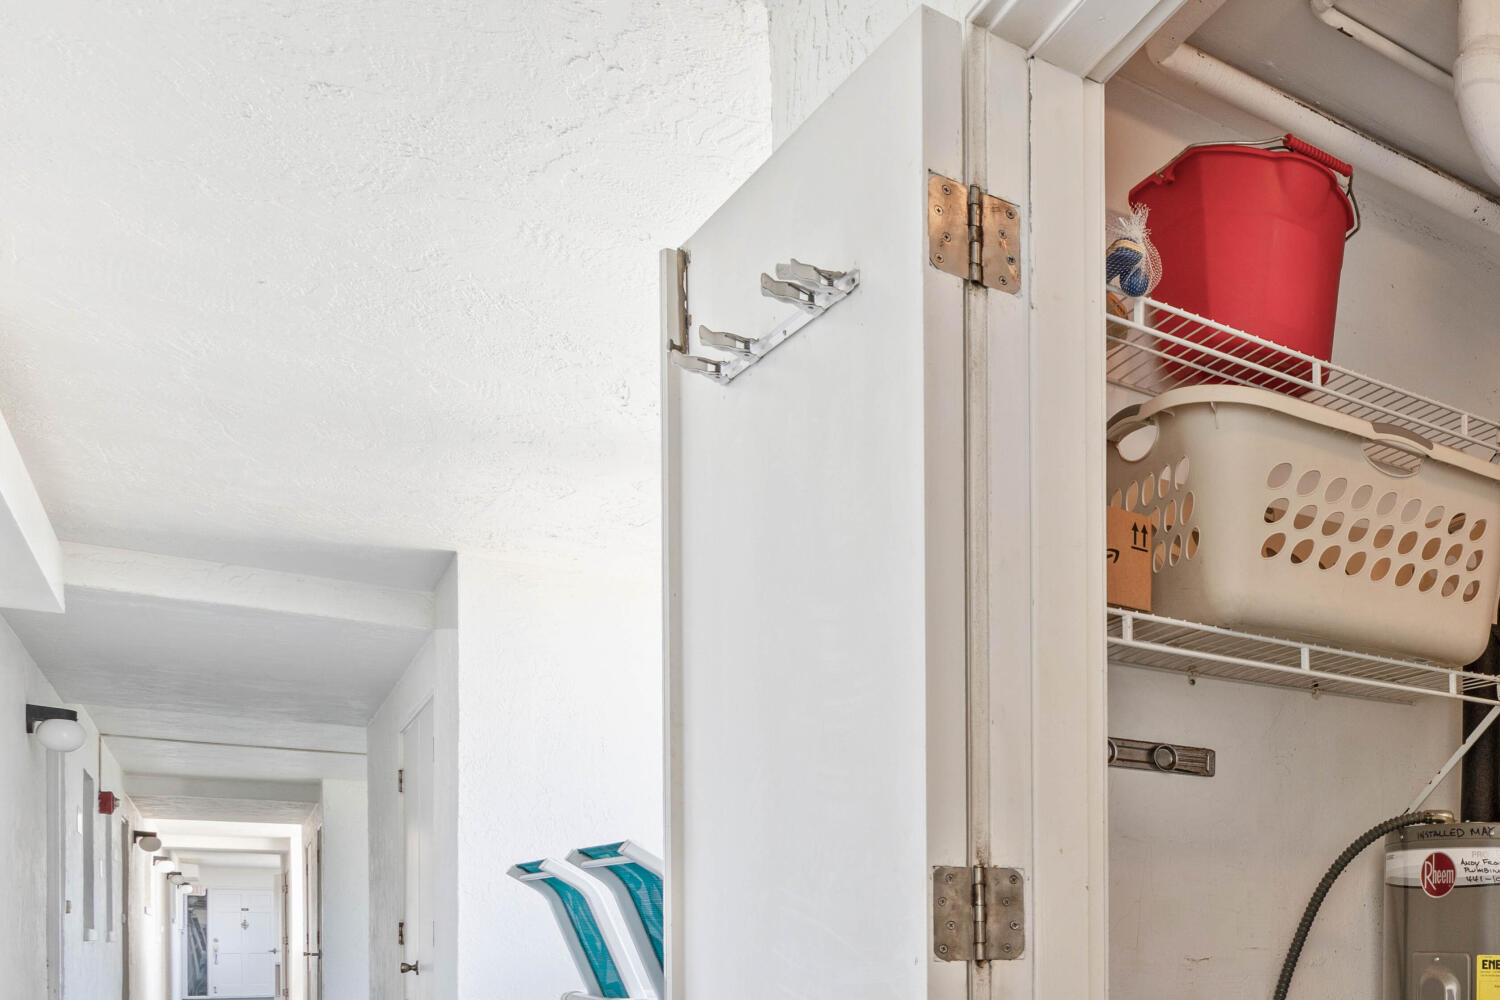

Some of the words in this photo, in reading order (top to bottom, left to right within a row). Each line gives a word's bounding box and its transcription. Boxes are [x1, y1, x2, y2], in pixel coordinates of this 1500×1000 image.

[1417, 828, 1465, 840] INSTALLED
[1470, 826, 1496, 838] MAY
[1423, 854, 1455, 891] Rheem
